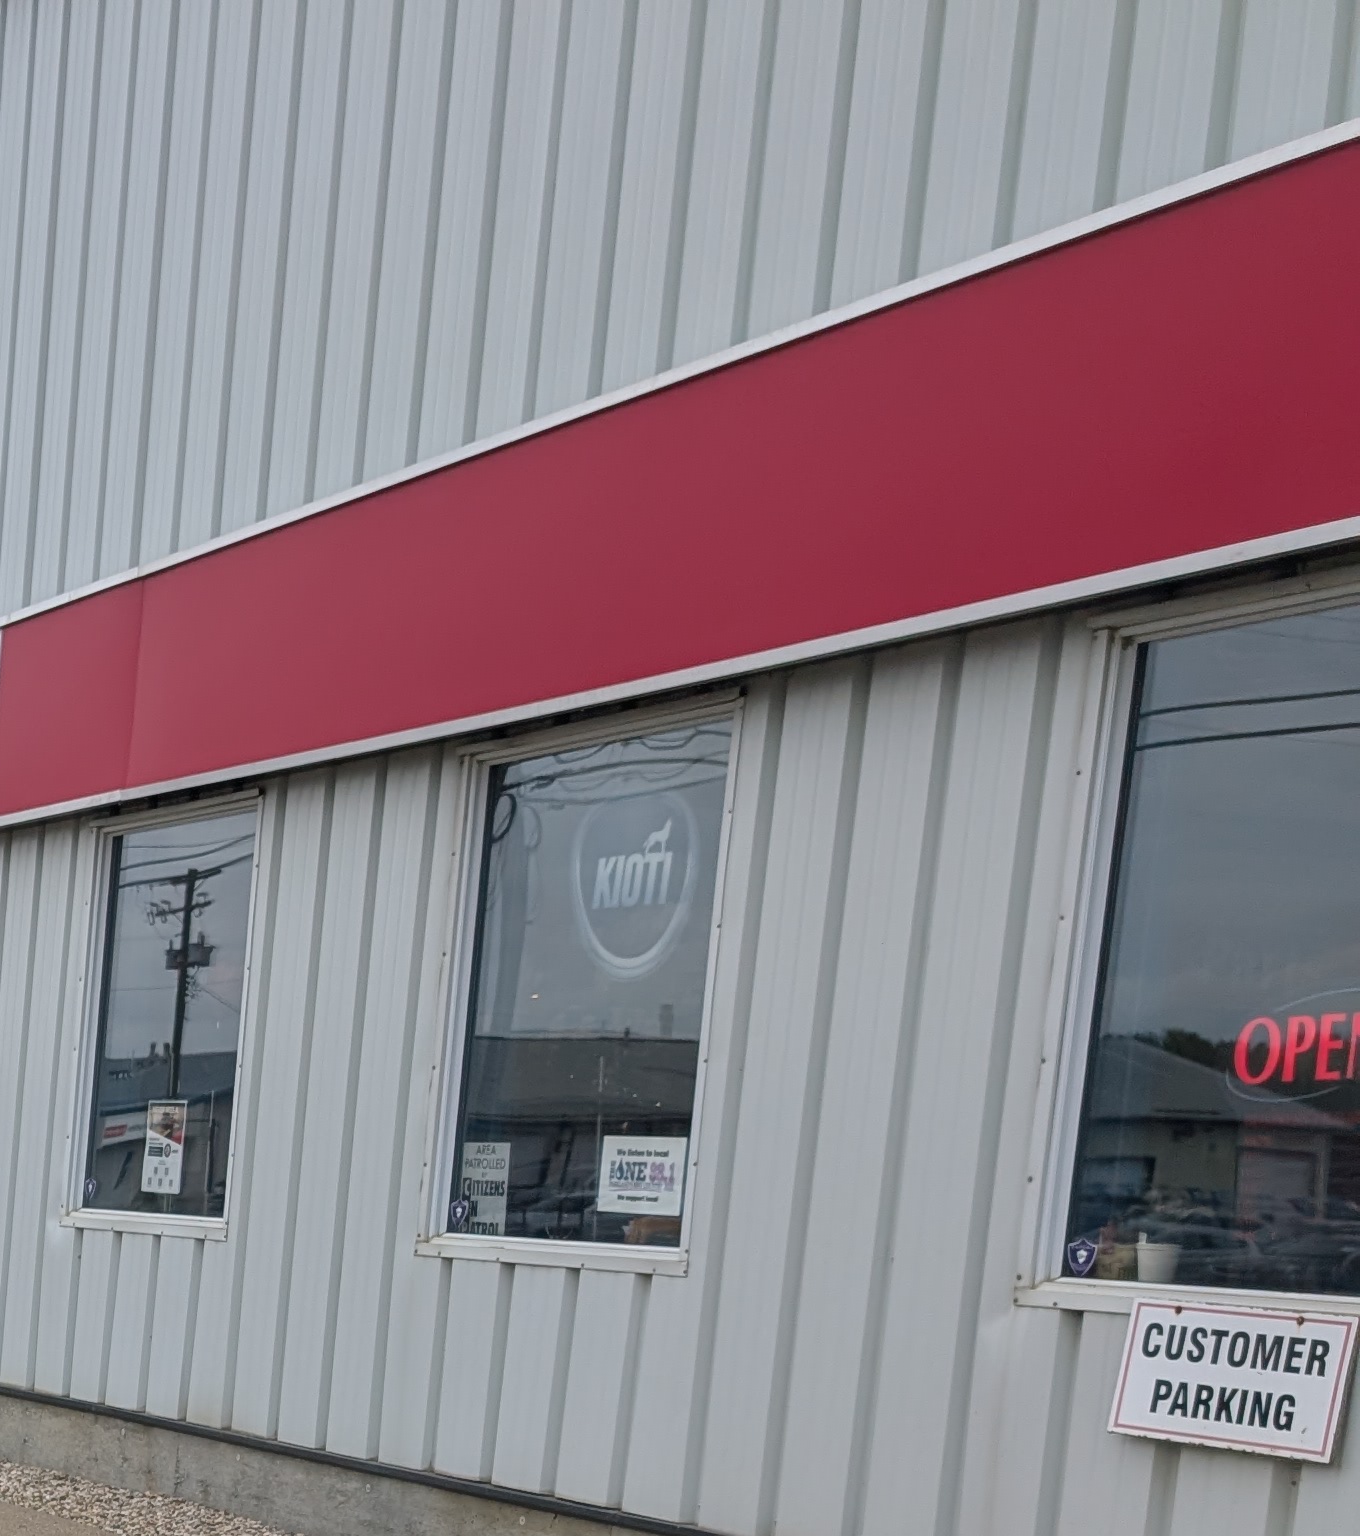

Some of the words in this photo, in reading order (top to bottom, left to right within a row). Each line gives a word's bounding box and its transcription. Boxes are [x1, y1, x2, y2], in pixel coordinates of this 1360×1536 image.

[591, 851, 674, 910] KIOTI
[476, 1145, 496, 1156] AREA
[627, 1149, 645, 1157] listen
[654, 1150, 670, 1158] local
[464, 1158, 506, 1170] PATROLLED
[463, 1178, 506, 1197] CITIZENS
[1142, 1322, 1330, 1378] CUSTOMER
[1149, 1378, 1296, 1432] PARKING
